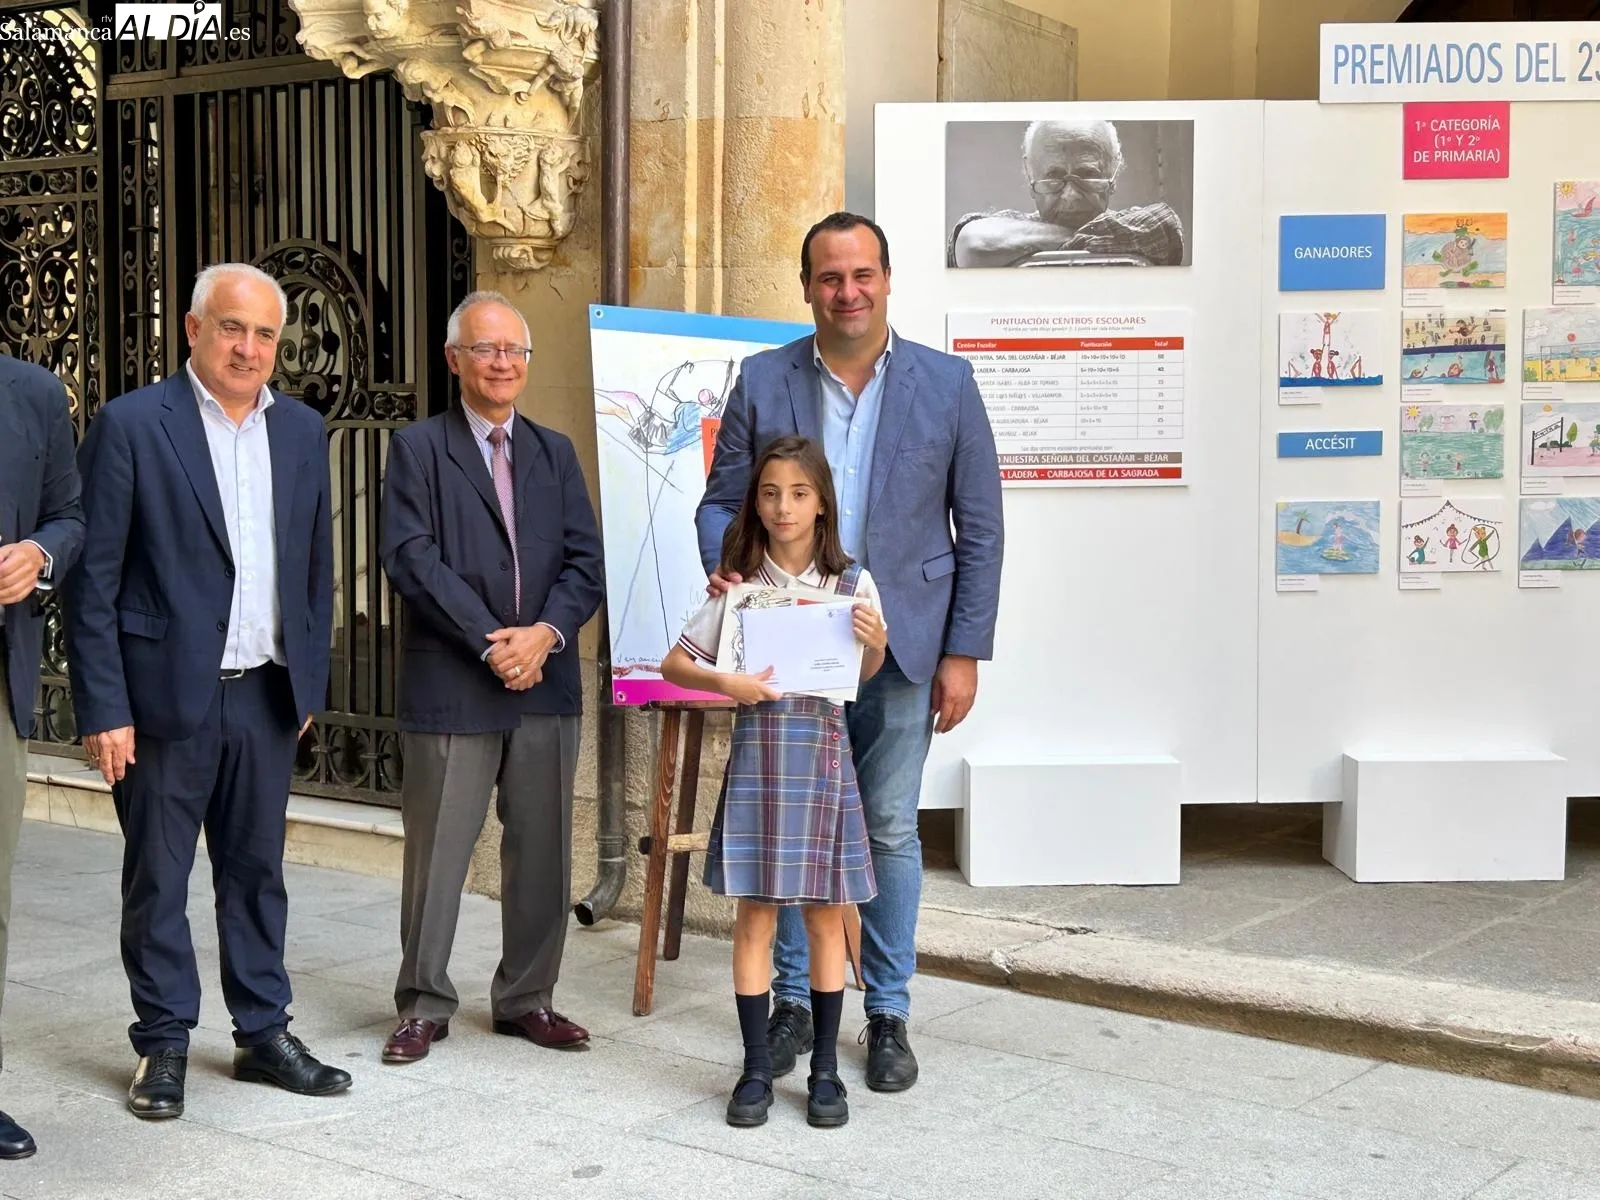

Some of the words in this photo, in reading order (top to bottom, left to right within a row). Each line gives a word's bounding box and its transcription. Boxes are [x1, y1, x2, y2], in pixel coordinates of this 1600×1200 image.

[1333, 41, 1504, 85] PREMIADOS
[1515, 42, 1566, 83] DEL
[1430, 114, 1501, 131] CATEGORÍA
[1456, 134, 1464, 146] Y
[1413, 150, 1430, 162] DE
[1434, 148, 1500, 163] PRIMARIA)
[1294, 245, 1372, 260] GANADORES
[991, 316, 1049, 325] PUNTUACIÓN
[1052, 316, 1093, 325] CENTROS
[1096, 316, 1147, 324] ESCOLARES
[1305, 434, 1357, 450] ACCÉSIT
[1003, 455, 1040, 464] NUESTRA
[1041, 453, 1074, 464] SEÑORA
[1076, 454, 1090, 463] DEL
[1092, 452, 1135, 462] CASTAÑAR
[1144, 452, 1168, 462] BÉJAR
[1007, 470, 1039, 479] LADERA
[1047, 469, 1093, 479] CARBAJOSA
[1096, 469, 1106, 477] DE
[1108, 469, 1118, 478] LA
[1120, 468, 1160, 477] SAGRADA
